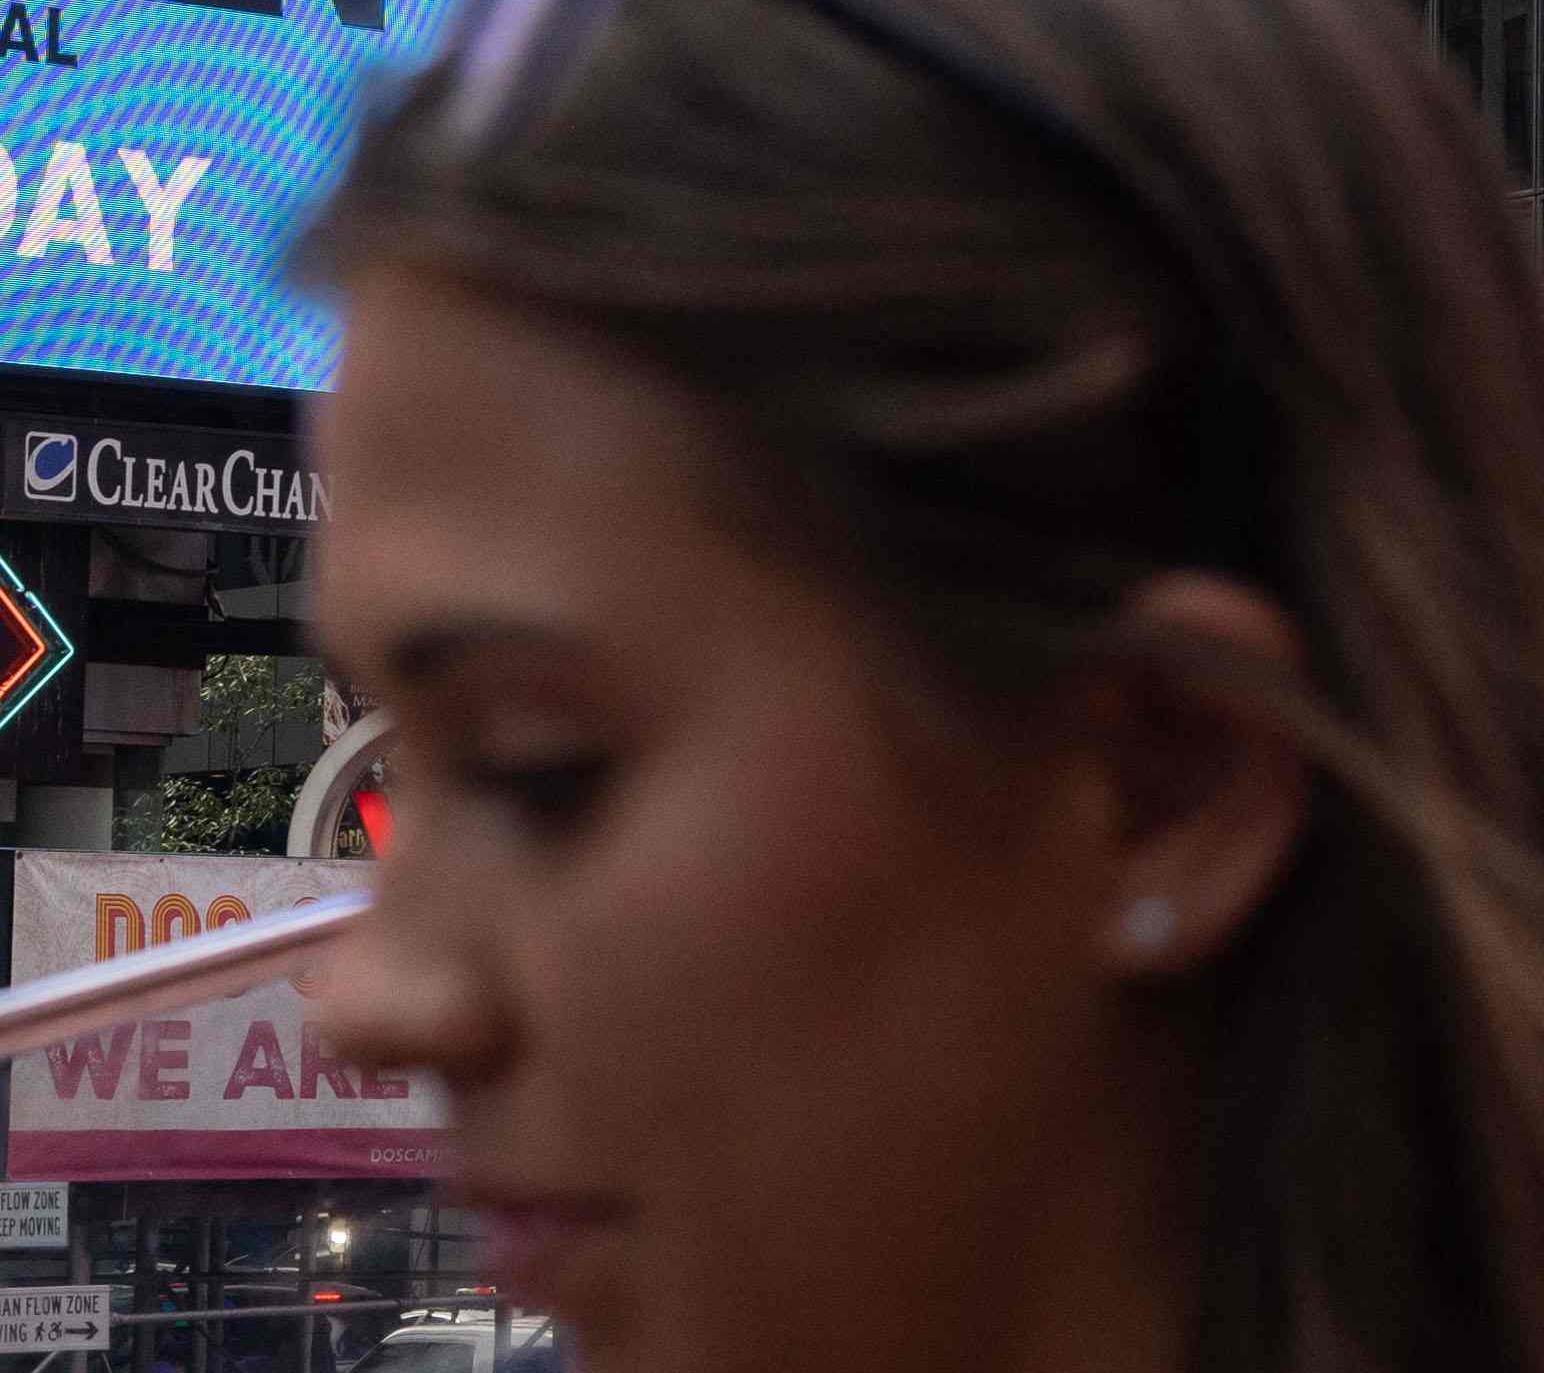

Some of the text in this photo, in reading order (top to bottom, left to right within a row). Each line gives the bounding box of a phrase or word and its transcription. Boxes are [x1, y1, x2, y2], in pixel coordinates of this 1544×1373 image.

[0, 2, 78, 68] AL
[0, 140, 211, 272] AY
[45, 1020, 191, 1100] WE
[1, 1191, 60, 1211] FLOW ZONE
[20, 1217, 61, 1236] MOVING
[26, 1296, 62, 1317] FLOW
[66, 1295, 100, 1315] ZONE
